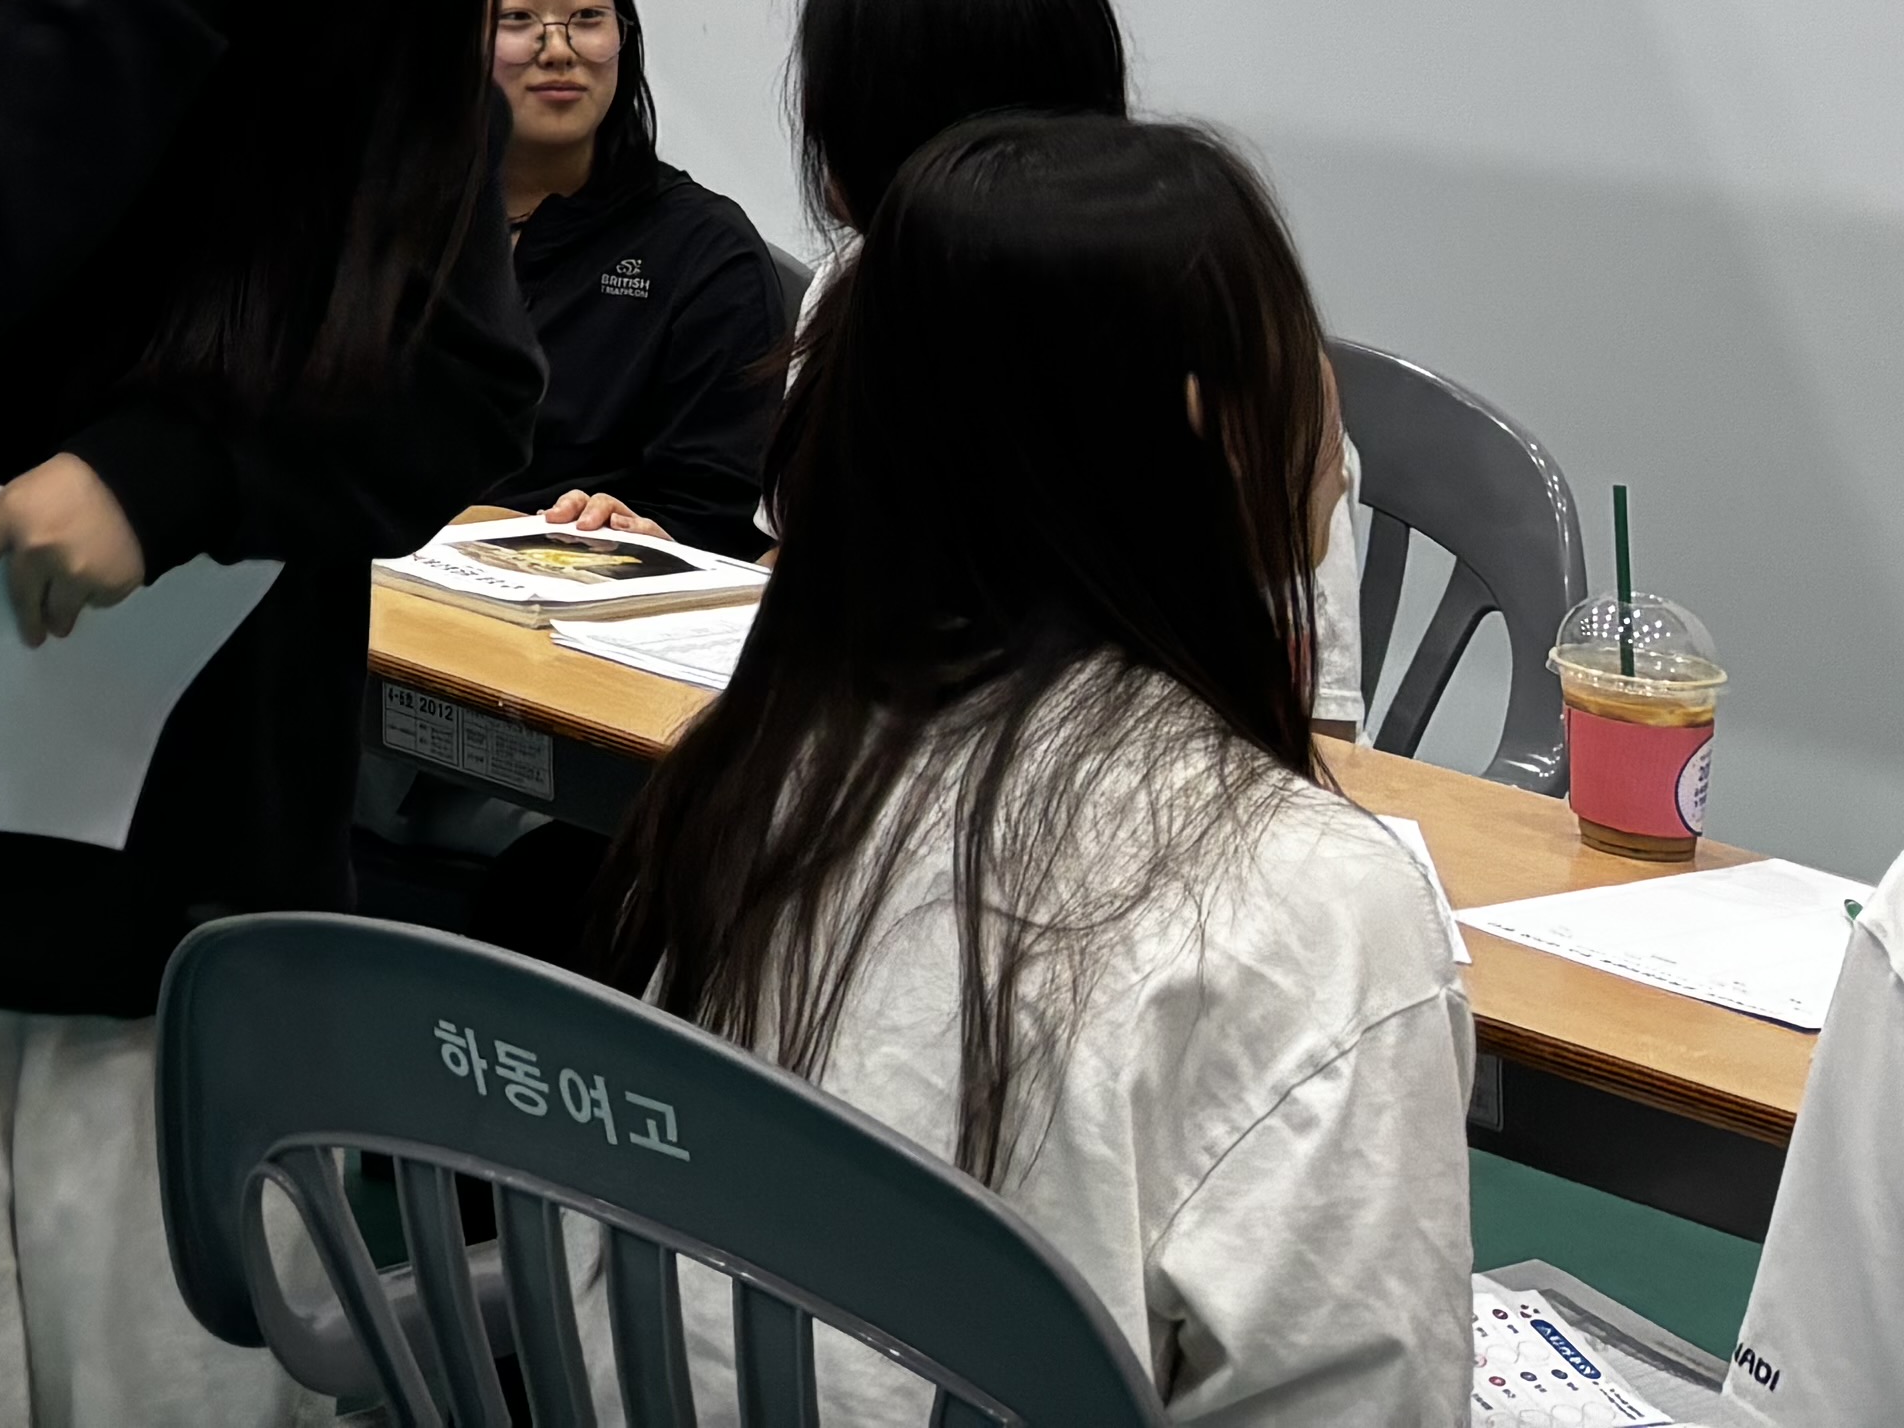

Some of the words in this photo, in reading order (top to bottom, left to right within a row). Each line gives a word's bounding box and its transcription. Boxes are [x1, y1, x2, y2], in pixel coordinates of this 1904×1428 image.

[601, 273, 650, 290] BRITISH
[419, 696, 454, 721] 2012
[434, 1019, 690, 1162] 하동여고
